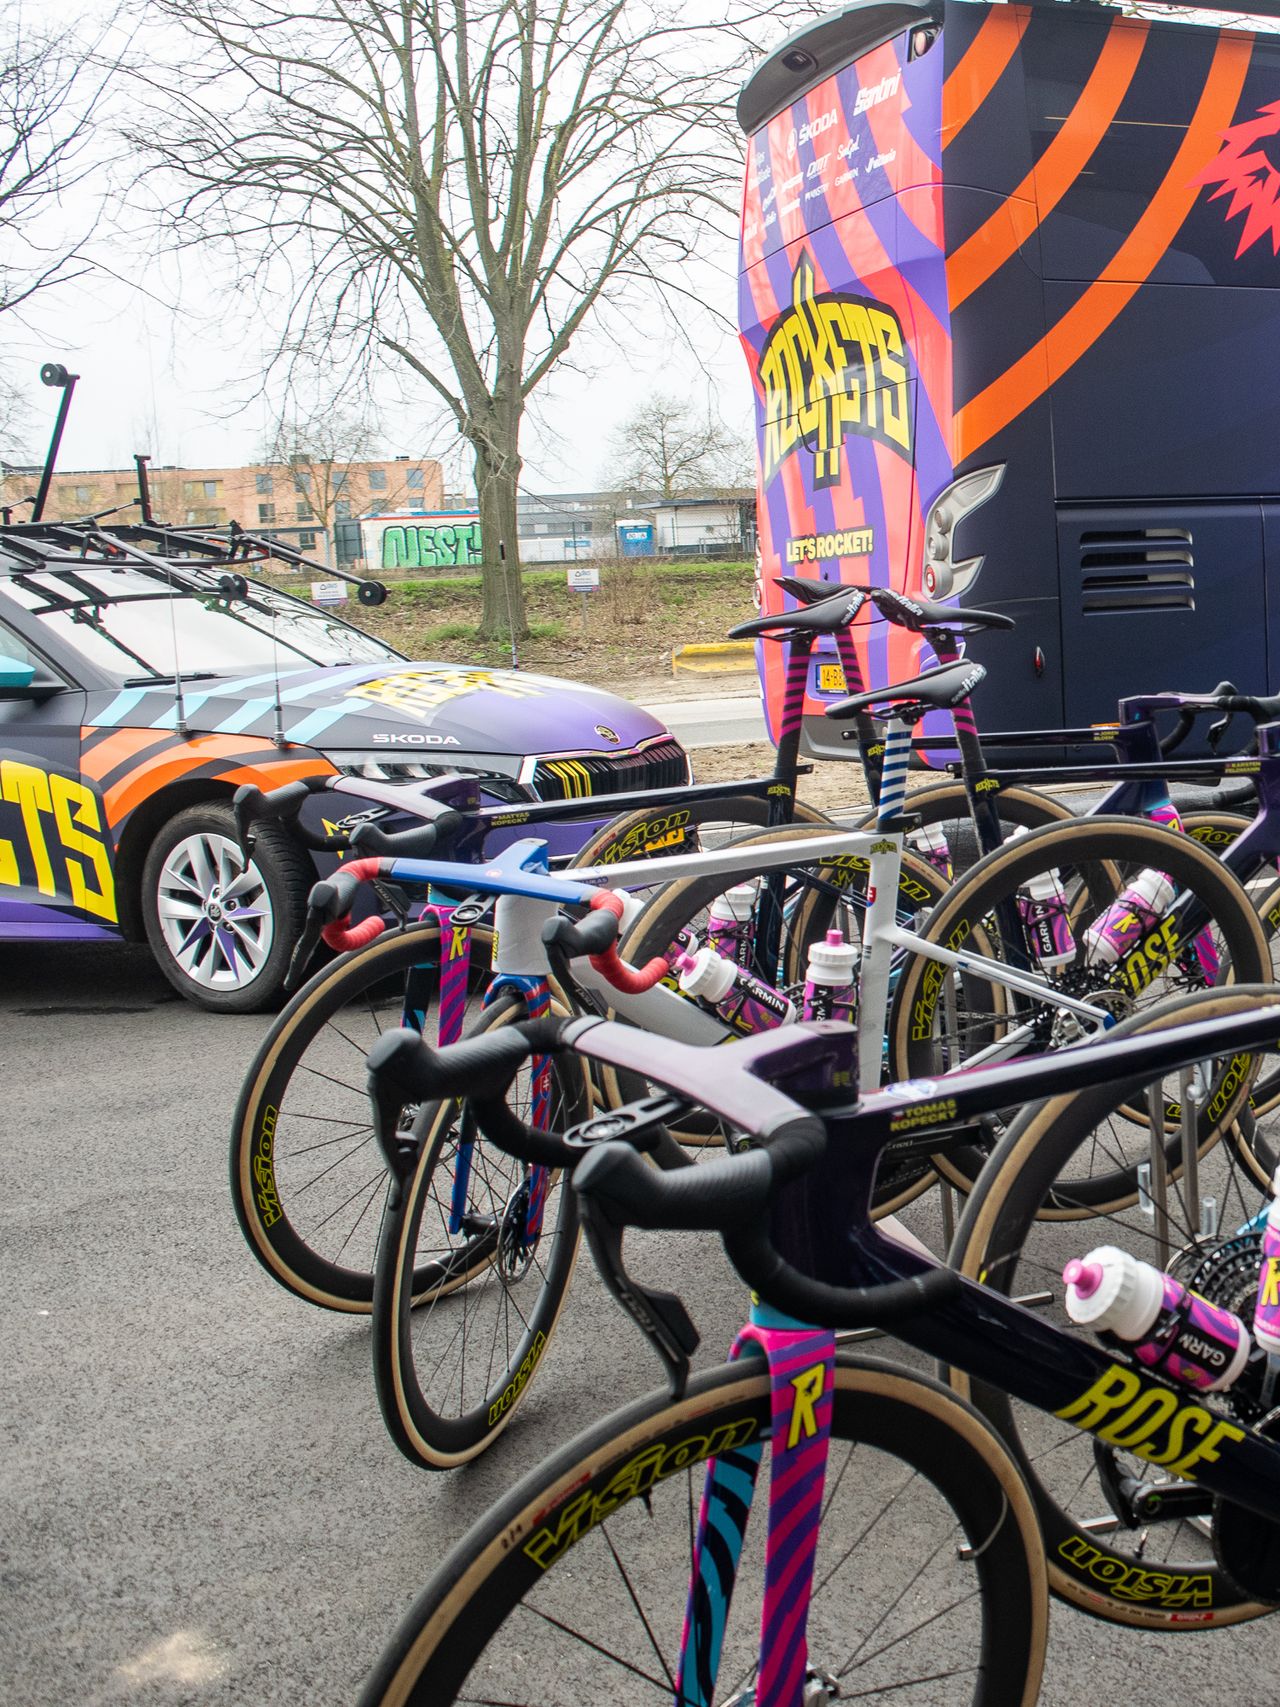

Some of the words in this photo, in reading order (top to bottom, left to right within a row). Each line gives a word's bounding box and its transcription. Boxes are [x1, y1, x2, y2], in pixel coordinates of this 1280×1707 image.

[853, 67, 902, 116] Santini
[799, 109, 838, 146] ŠKODA
[761, 264, 910, 481] ROCKETS
[786, 538, 817, 563] LET'S
[816, 529, 874, 559] ROCKET!
[372, 733, 461, 746] SKODA
[449, 926, 468, 961] R
[889, 1108, 958, 1132] KOPECKY
[905, 1098, 957, 1118] TOMAS
[787, 1362, 826, 1450] R
[1054, 1363, 1247, 1480] ROSE
